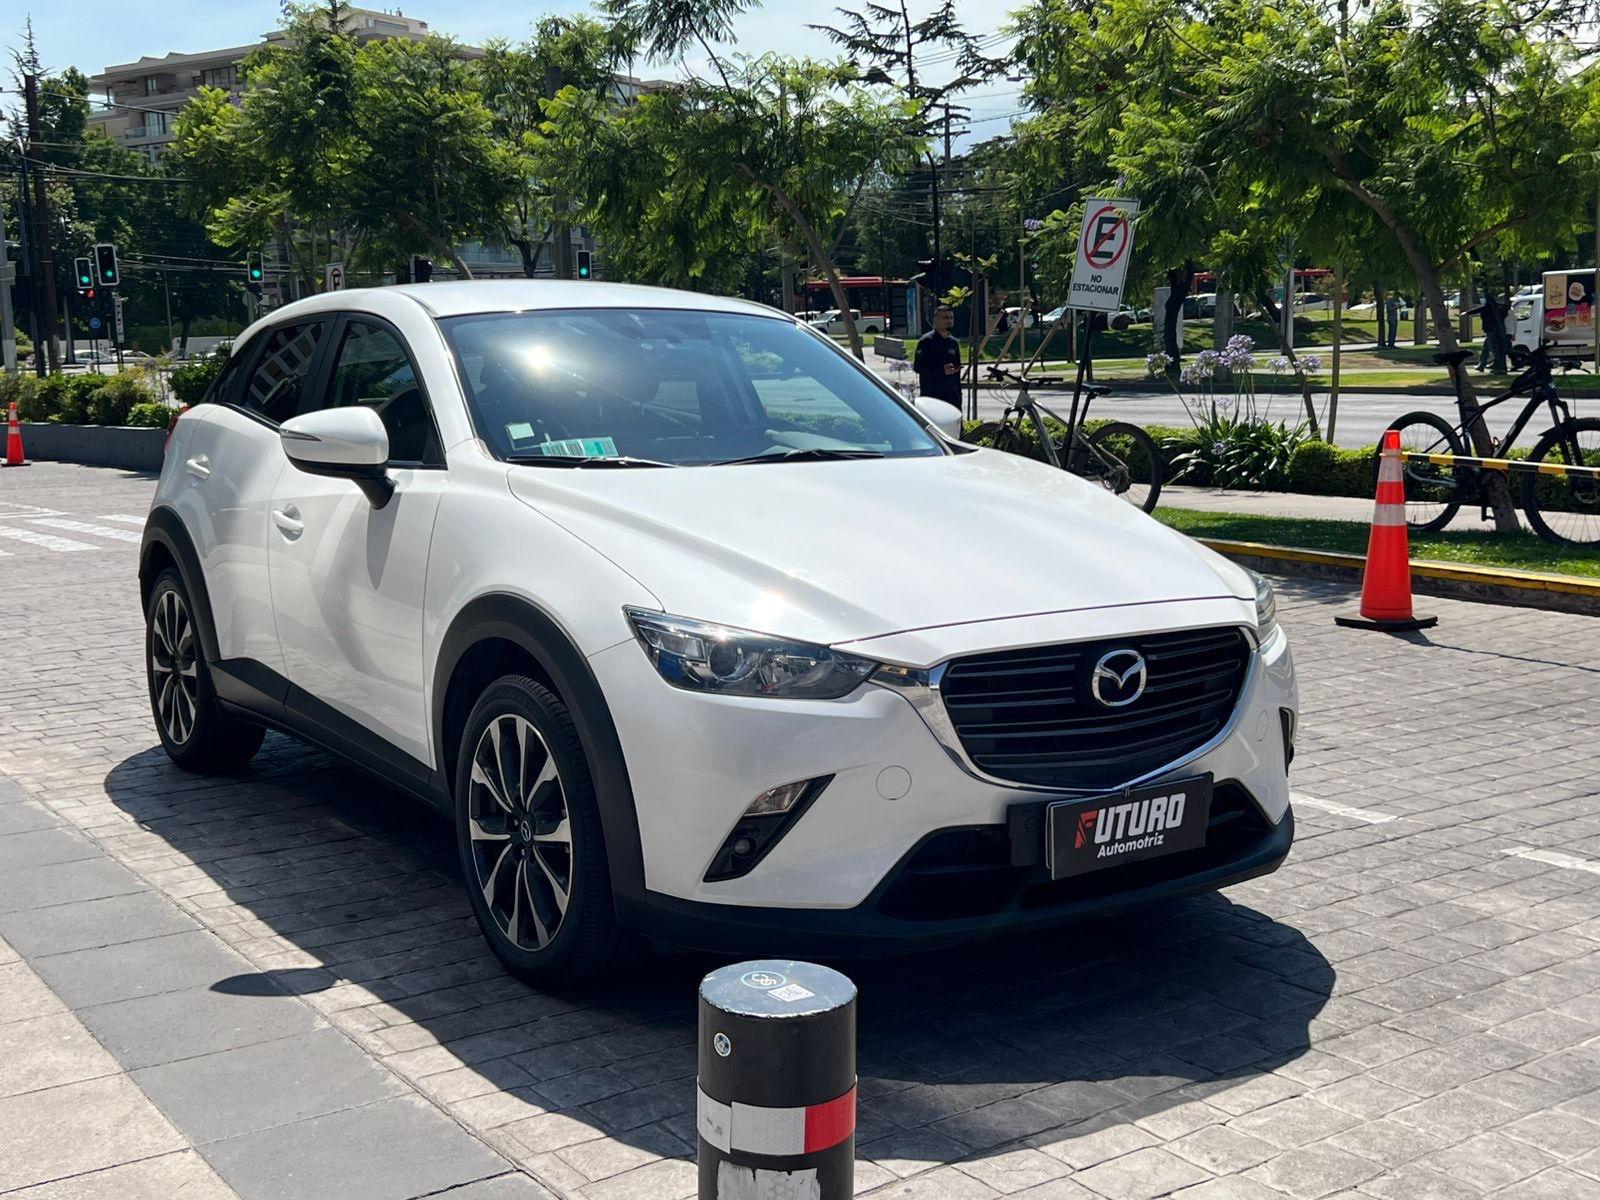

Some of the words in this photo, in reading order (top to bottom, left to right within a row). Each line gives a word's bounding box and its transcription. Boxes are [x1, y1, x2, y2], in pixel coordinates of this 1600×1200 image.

[1091, 216, 1121, 259] E
[1072, 283, 1119, 295] ESTACIONAR
[1091, 275, 1102, 283] NO
[1074, 793, 1186, 848] FUTURO
[1097, 833, 1164, 858] Automotriz
